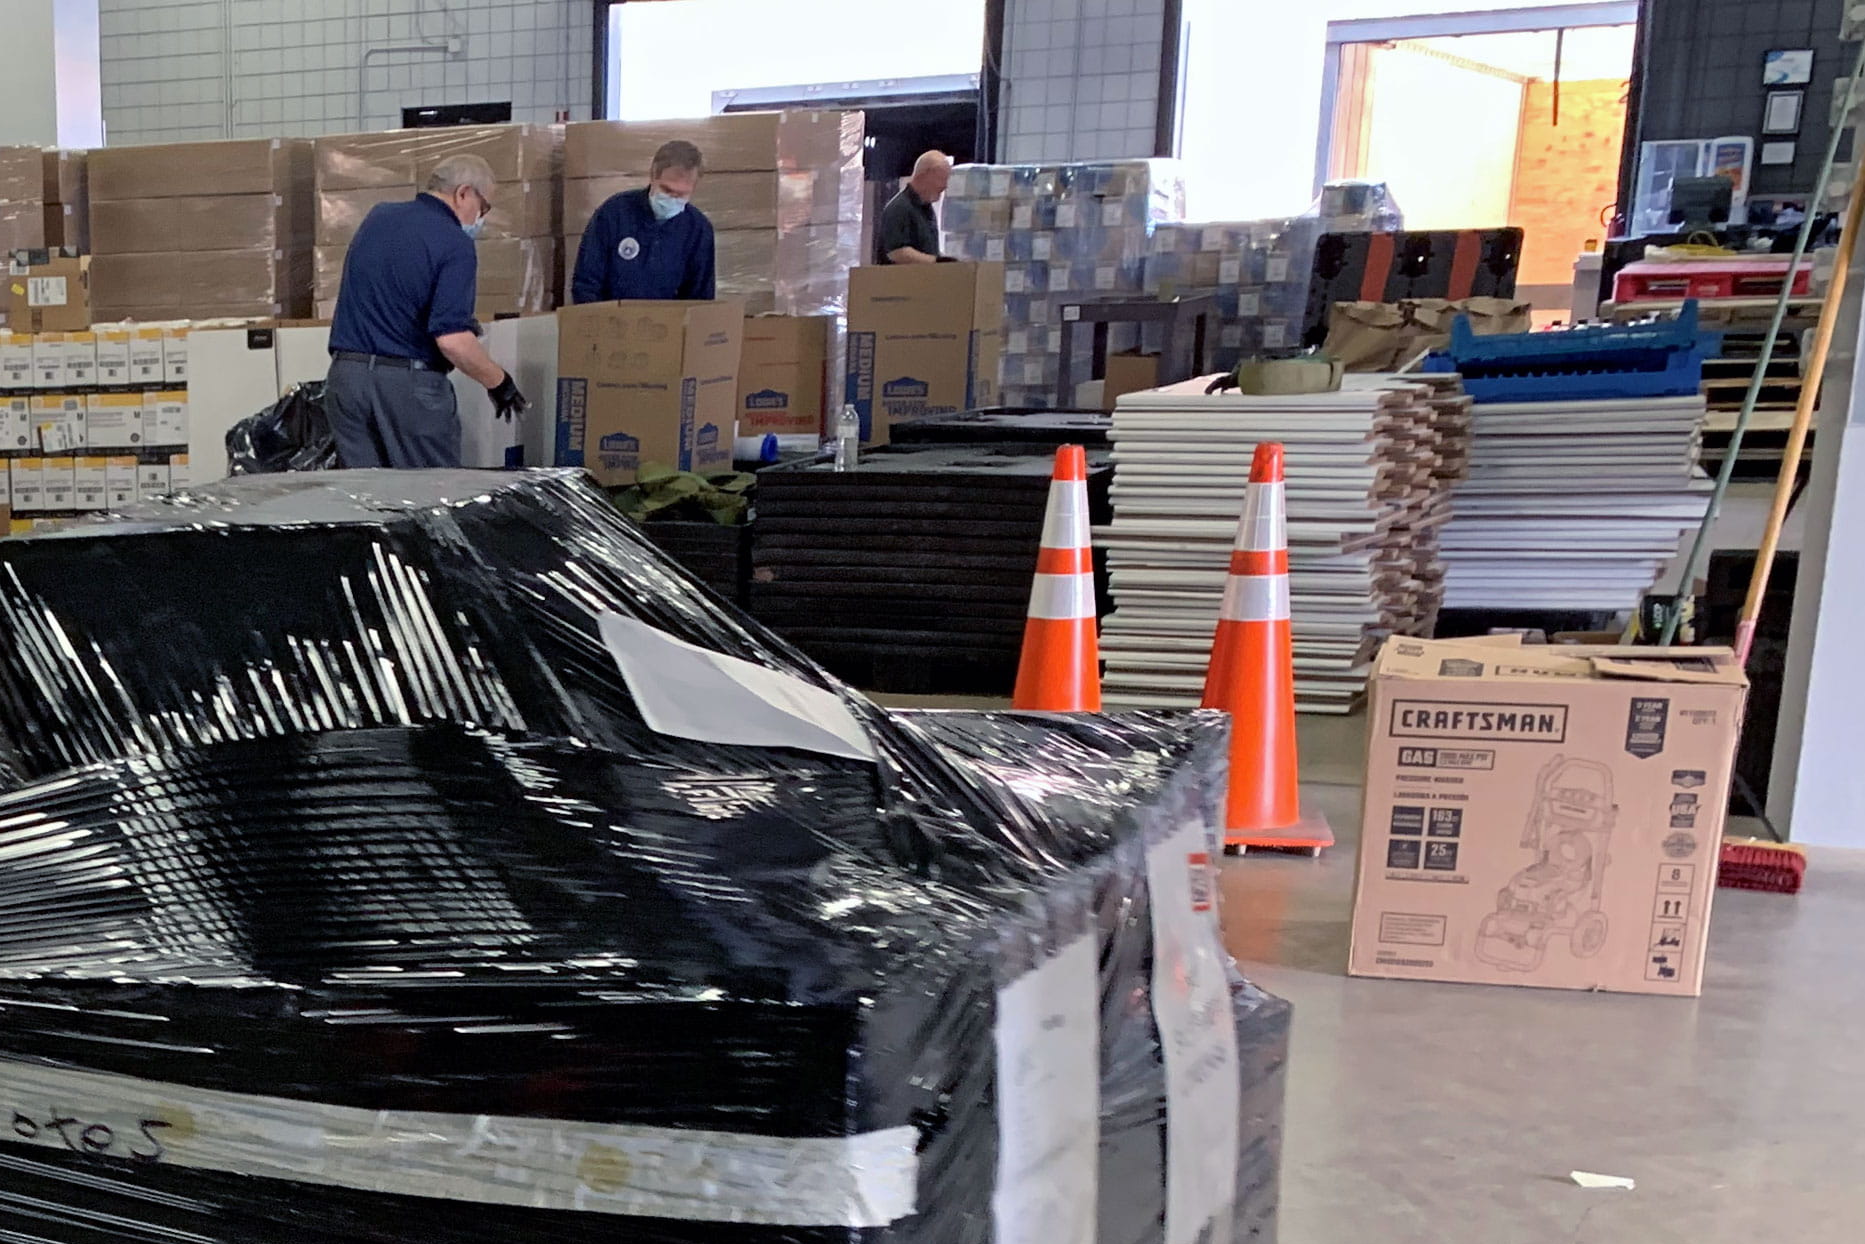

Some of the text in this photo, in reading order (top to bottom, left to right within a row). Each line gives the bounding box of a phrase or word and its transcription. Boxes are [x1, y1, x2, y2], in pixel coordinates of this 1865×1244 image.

[569, 381, 585, 450] MEDIUM
[1401, 709, 1556, 733] CRAFTSMAN
[1401, 750, 1434, 766] GAS
